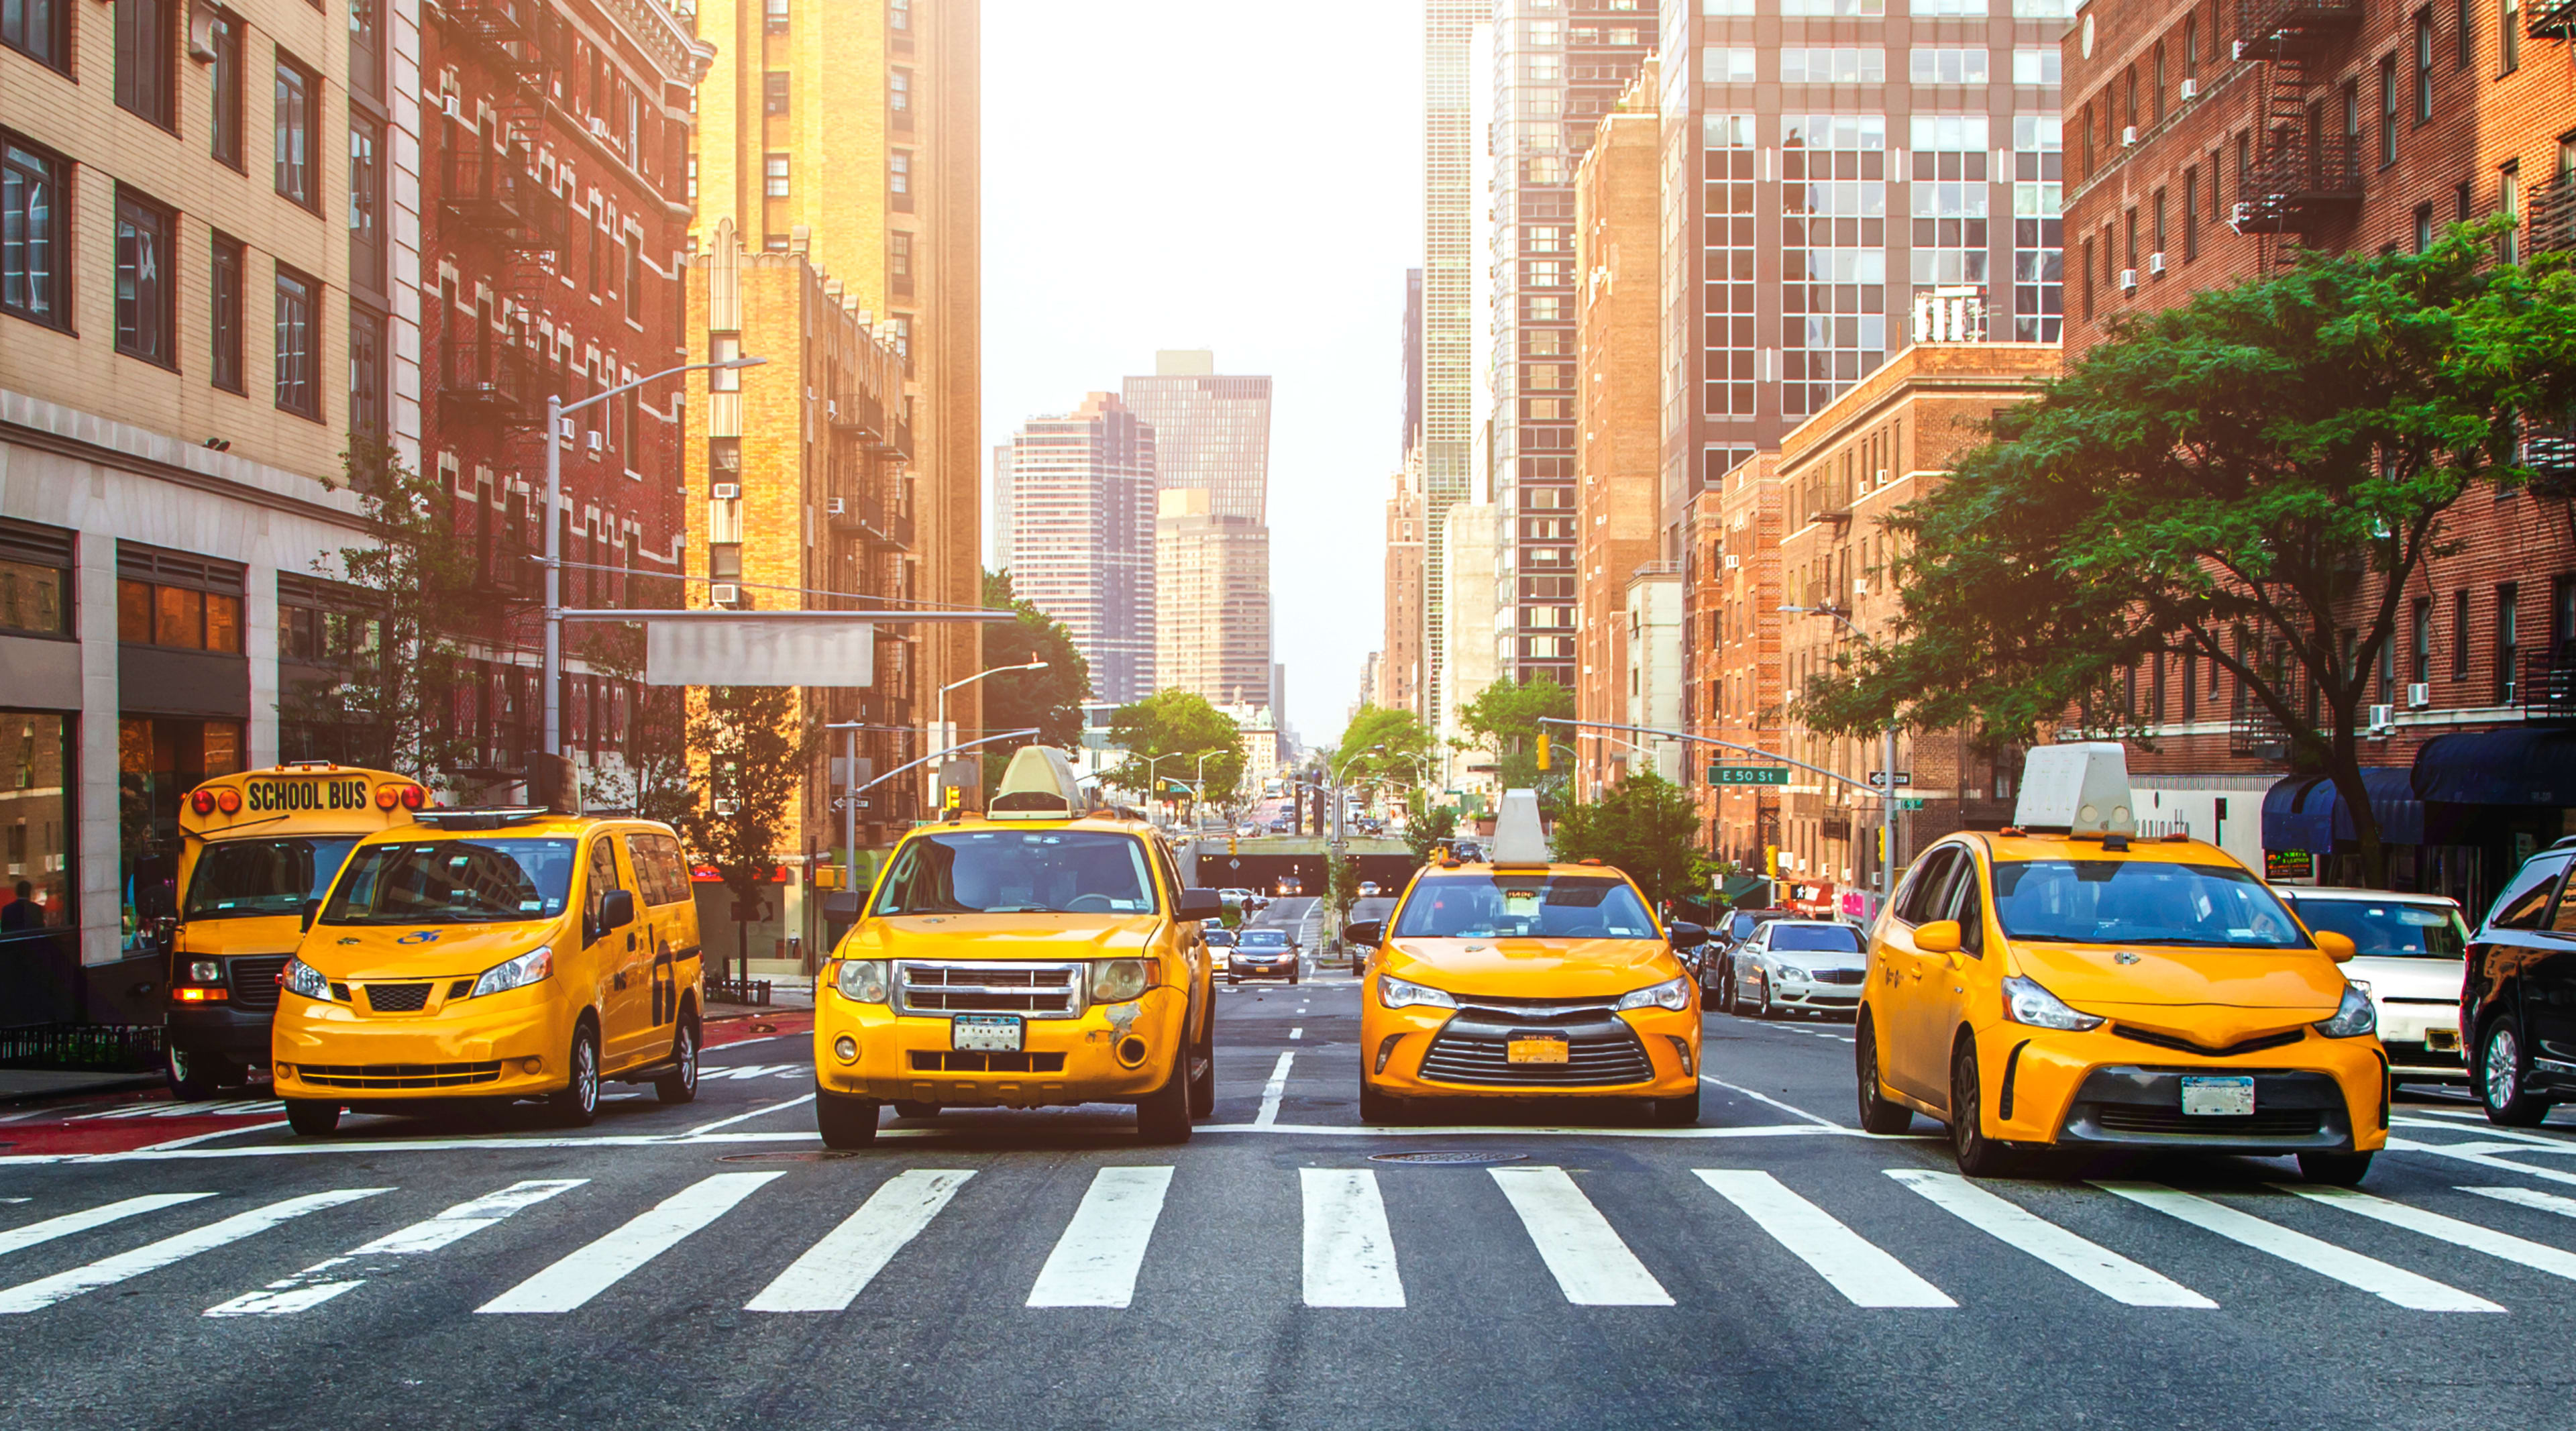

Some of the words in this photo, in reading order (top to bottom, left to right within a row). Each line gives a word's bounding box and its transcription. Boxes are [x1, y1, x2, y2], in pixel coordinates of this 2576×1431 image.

[1723, 771, 1730, 781] E
[1735, 771, 1753, 781] 50
[1758, 771, 1774, 782] St
[248, 782, 323, 810] SCHOOL
[329, 781, 366, 809] BUS
